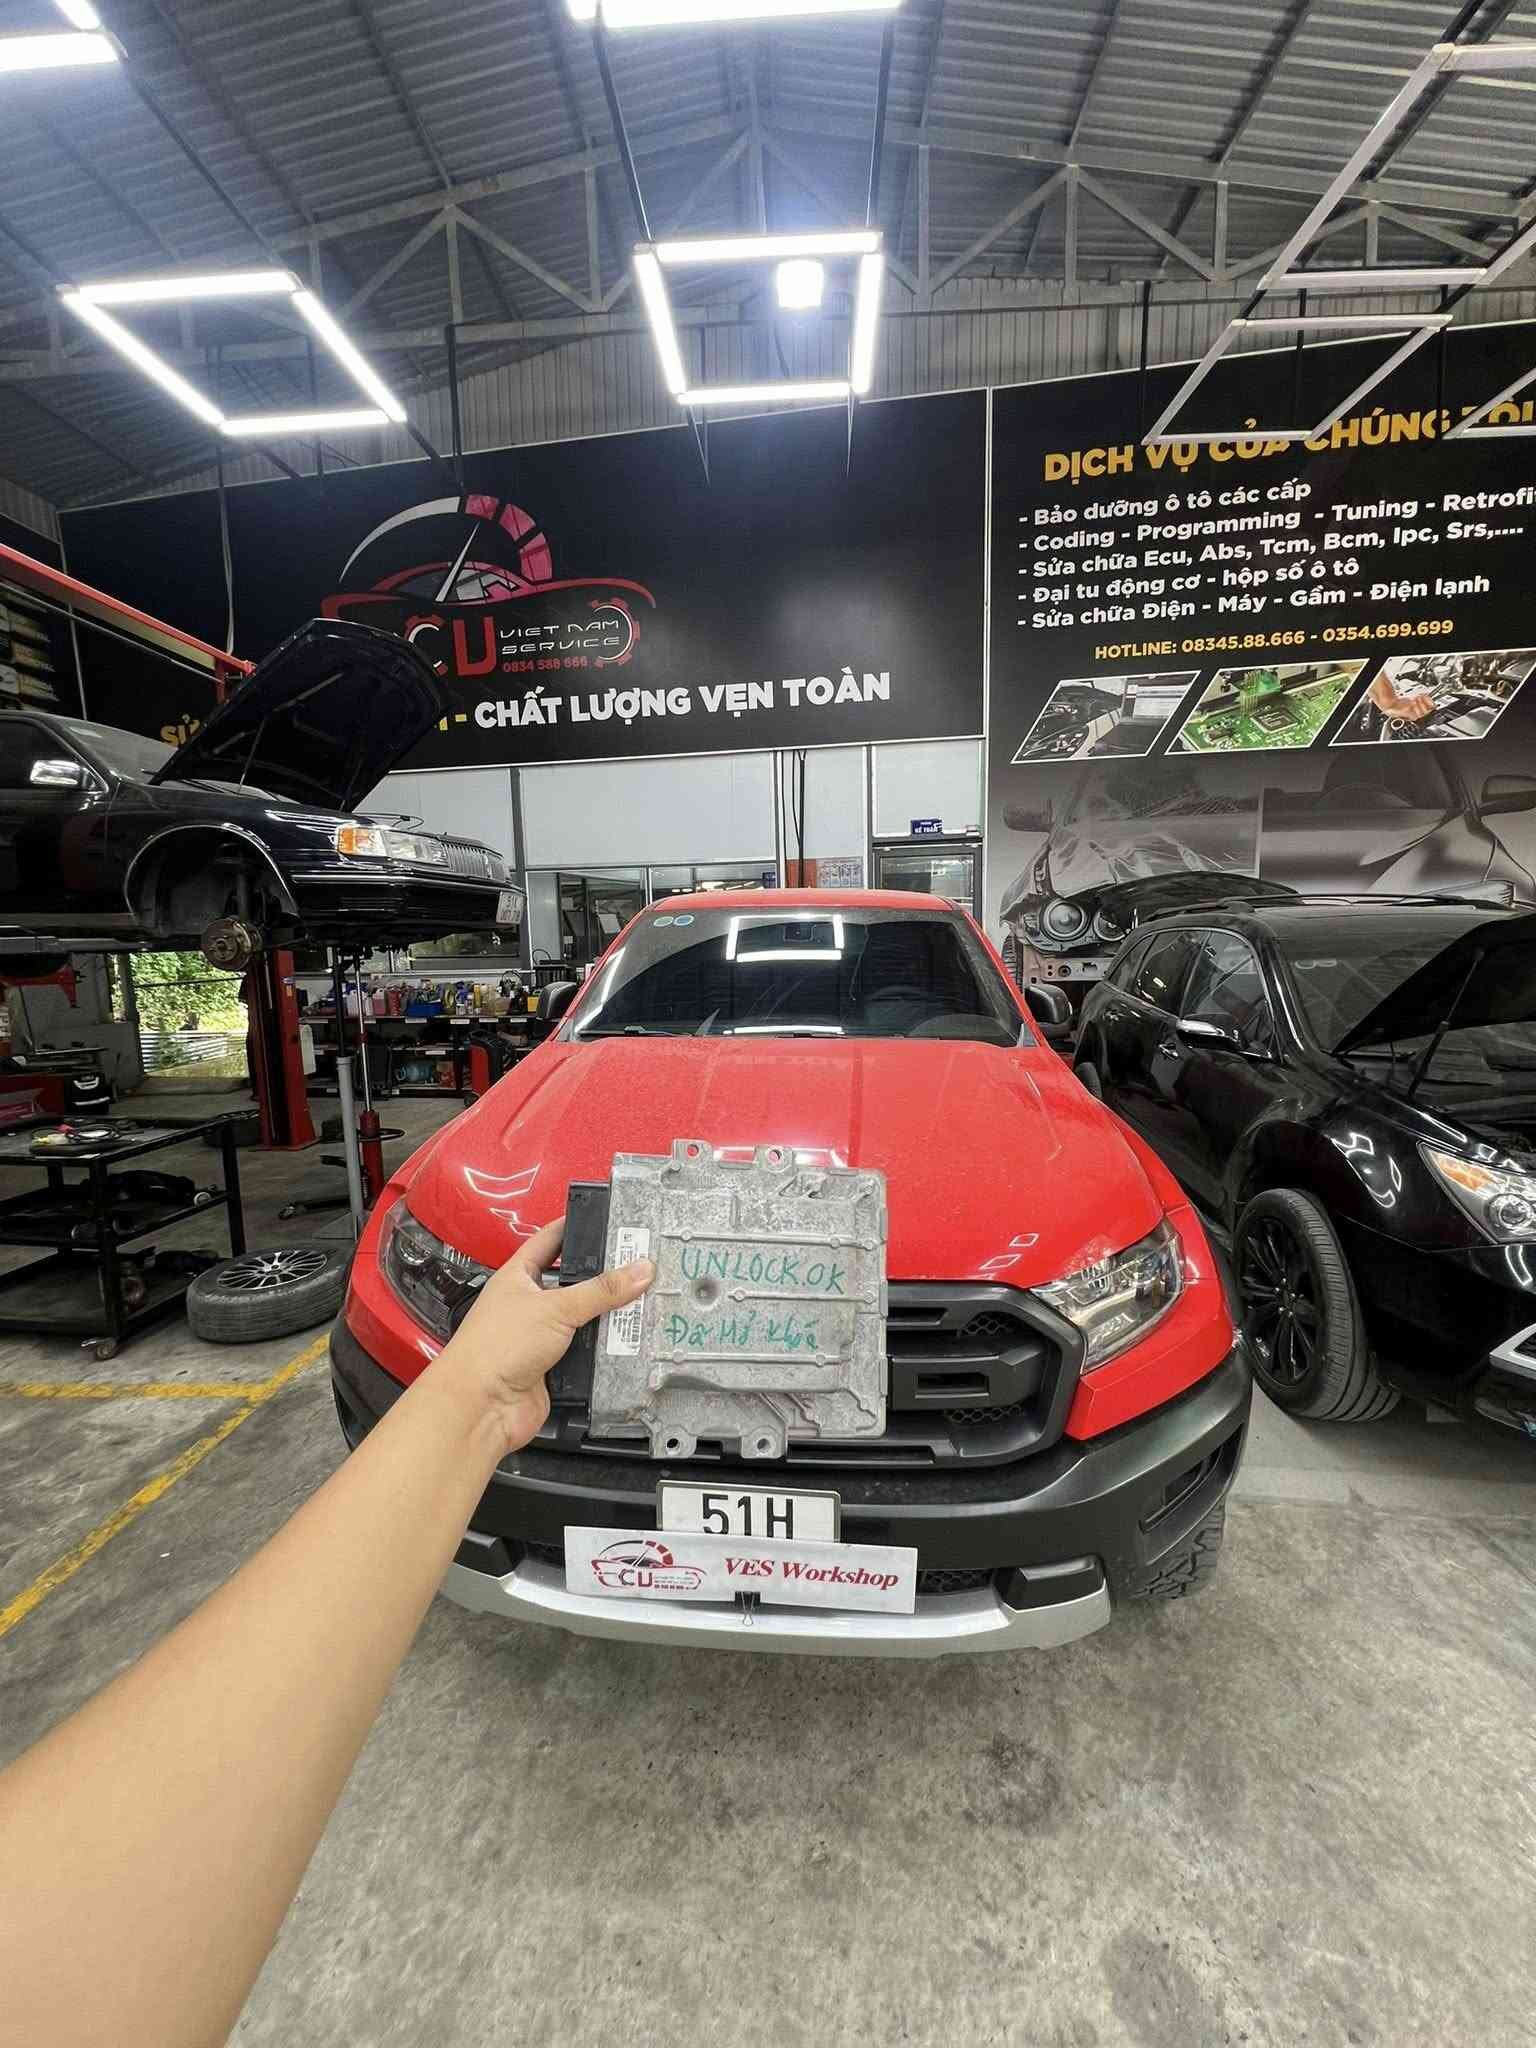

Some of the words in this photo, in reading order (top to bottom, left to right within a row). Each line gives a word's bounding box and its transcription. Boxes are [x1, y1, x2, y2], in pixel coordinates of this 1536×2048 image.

[1045, 445, 1134, 485] DỊCH
[1145, 440, 1199, 473] VỤ
[1033, 530, 1115, 552] Coding
[1136, 511, 1301, 542] Programming
[1331, 499, 1419, 522] Tuning
[1034, 504, 1078, 526] Bảo
[1083, 499, 1159, 521] dưỡng
[1164, 493, 1181, 512] ô
[1186, 490, 1213, 509] tô
[1218, 486, 1261, 506] các
[1266, 477, 1312, 502] cấp
[1032, 556, 1076, 578] Sửa
[1081, 552, 1138, 574] chữa
[1144, 549, 1193, 567] Ecu,
[1199, 542, 1253, 562] Abs,
[1259, 538, 1317, 556] Tcm,
[1323, 531, 1386, 551] Bcm,
[1393, 526, 1440, 547] Ipc,
[1031, 608, 1074, 629] Sửa
[1080, 605, 1136, 625] chữa
[1141, 599, 1196, 622] Điện
[1218, 593, 1268, 614] Máy
[1289, 584, 1346, 608] Gầm
[1369, 580, 1428, 603] Điện
[1434, 575, 1490, 599] lạnh
[1032, 584, 1070, 606] Đại
[1076, 583, 1100, 600] tu
[1105, 577, 1166, 599] động
[1171, 573, 1202, 591] cơ
[1222, 566, 1270, 589] hộp
[1275, 558, 1307, 582] số
[1309, 560, 1327, 579] ô
[1332, 557, 1360, 577] tô
[500, 625, 560, 638] VIET
[567, 619, 619, 633] NAM
[501, 636, 620, 655] SERVICE
[1095, 640, 1177, 660] HOTLINE:
[1181, 630, 1306, 654] 08345.88.666
[1322, 619, 1454, 643] 0354.699.699
[474, 686, 563, 729] CHẤT
[570, 687, 692, 726] LƯỢNG
[698, 680, 775, 718] VẸN
[782, 665, 891, 708] TOÀN
[702, 1492, 794, 1540] 51H
[725, 1558, 776, 1577] VES
[782, 1561, 899, 1590] Workshop
